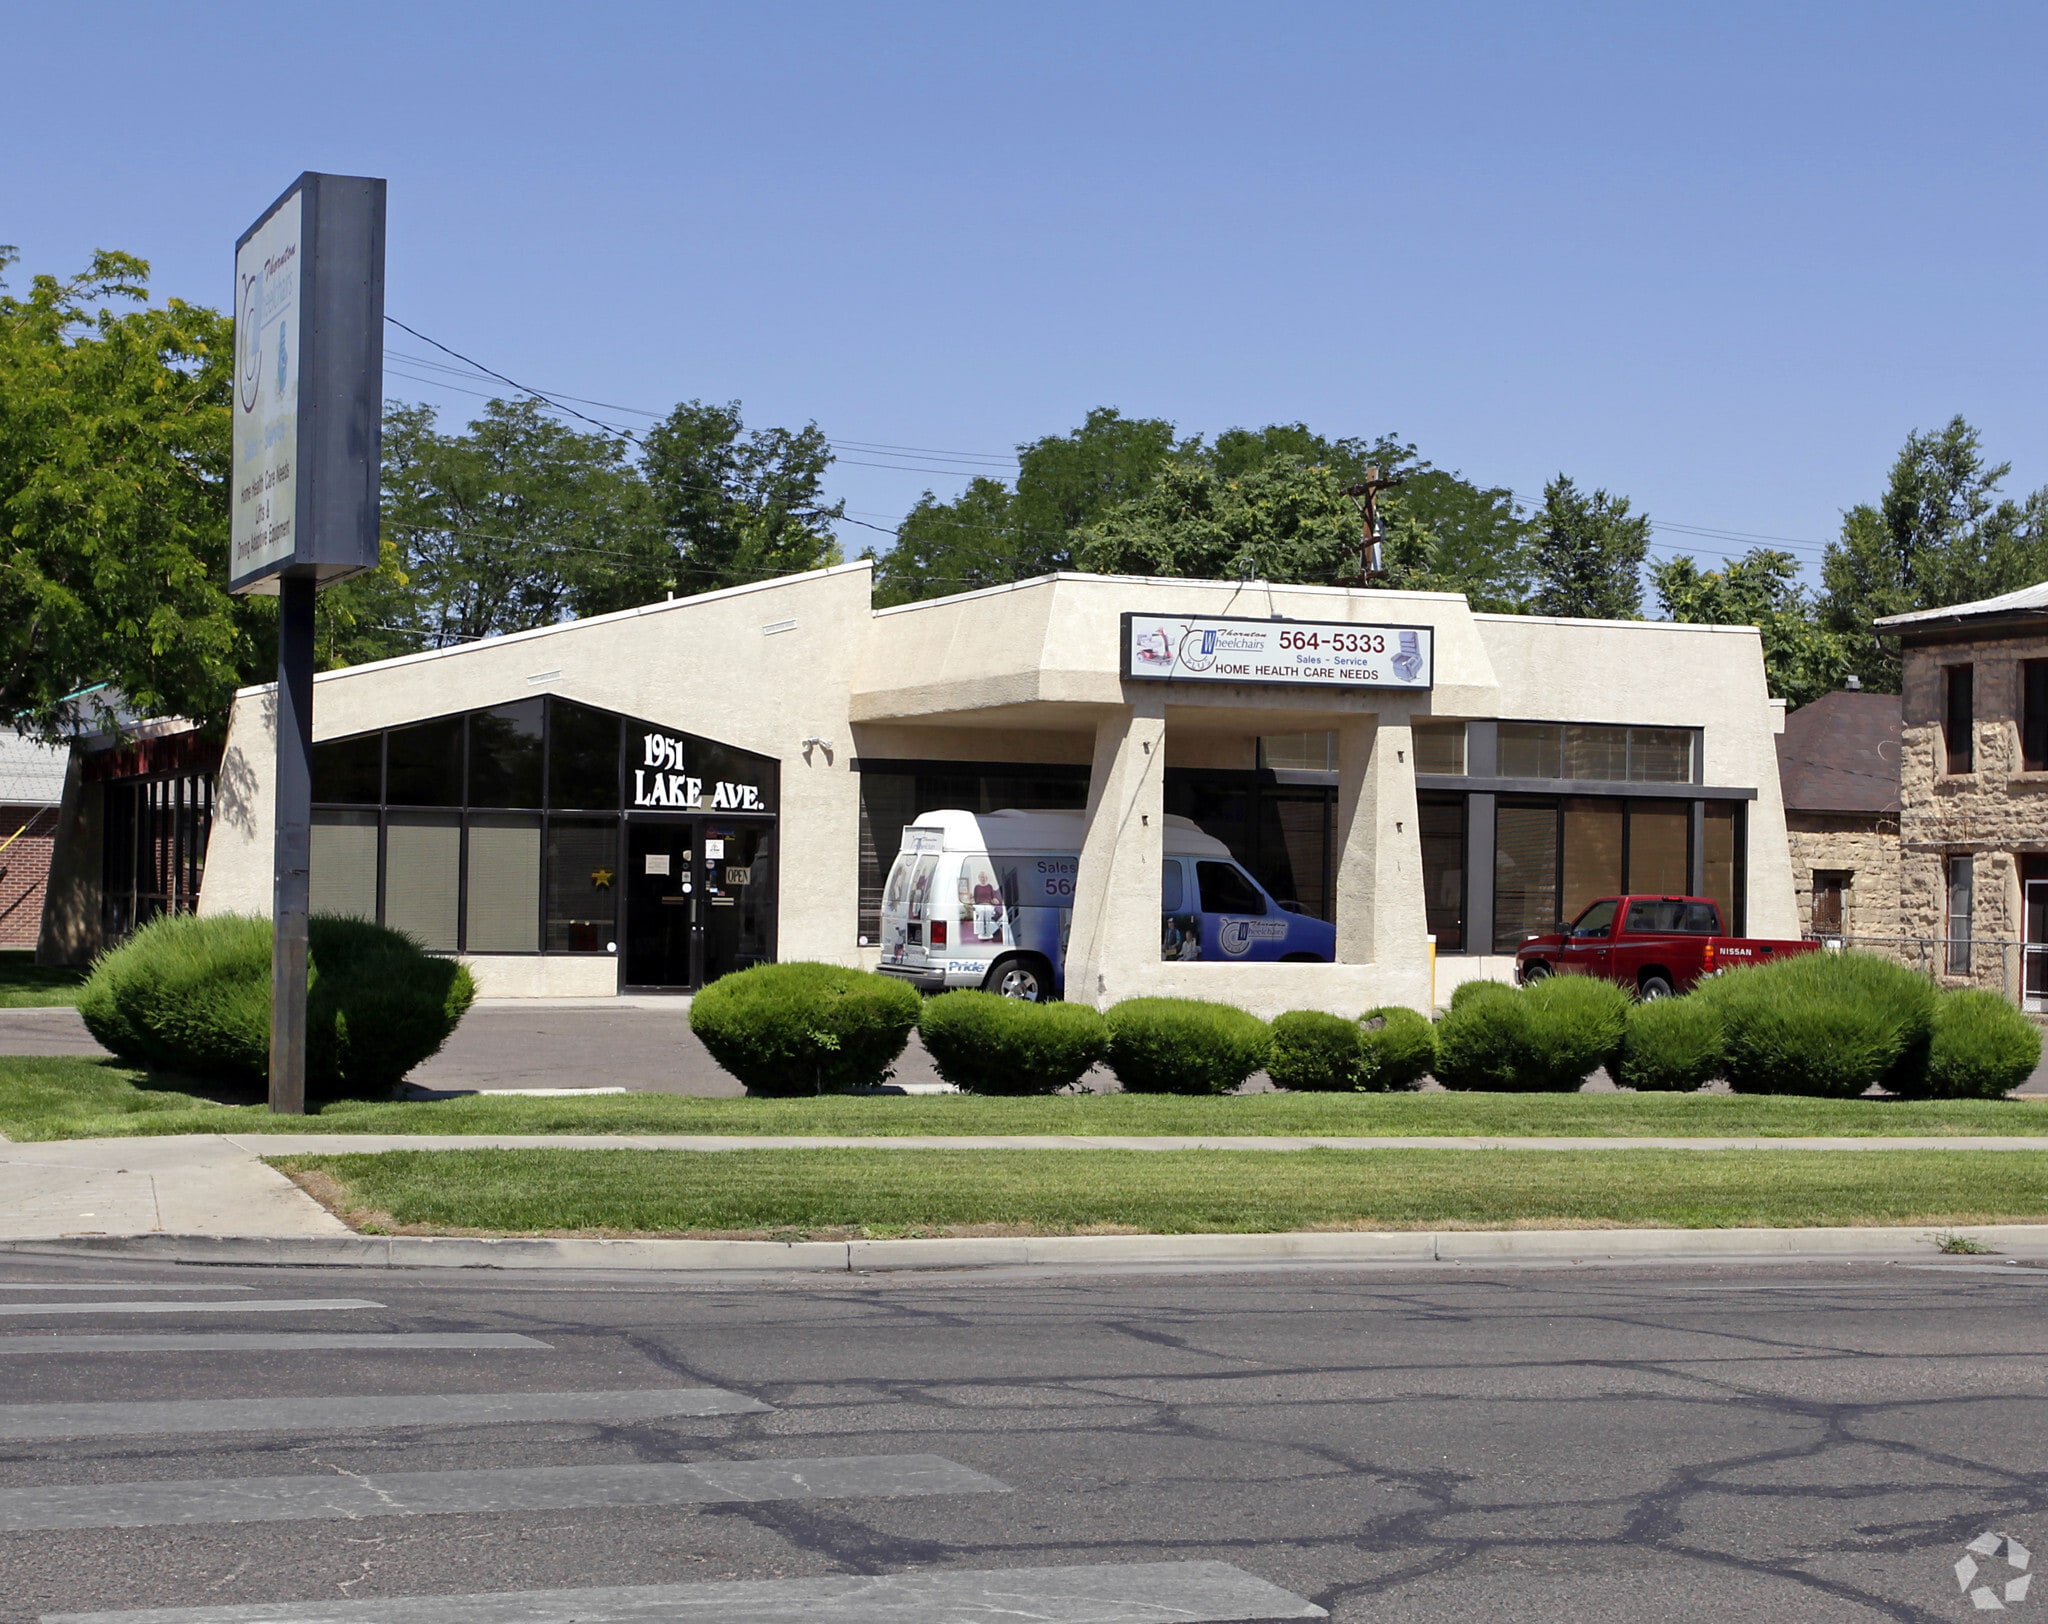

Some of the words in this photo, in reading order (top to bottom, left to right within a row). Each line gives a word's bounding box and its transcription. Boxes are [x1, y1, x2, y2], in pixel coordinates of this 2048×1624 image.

[1217, 629, 1267, 637] Thornton
[1202, 631, 1264, 653] Wheelchairs
[1279, 631, 1385, 653] 564-5333
[1296, 654, 1321, 664] Sales
[1334, 656, 1368, 666] Service
[1215, 664, 1250, 675] HOME
[1255, 665, 1299, 677] HEALTH
[1303, 667, 1334, 678] CARE
[1339, 669, 1379, 680] NEEDS
[643, 733, 685, 771] 1951
[634, 769, 702, 809] LAKE
[710, 781, 765, 810] AVE.
[1037, 861, 1077, 874] Sales
[727, 869, 748, 883] OPEN
[1719, 947, 1752, 956] NISSAN
[948, 961, 985, 973] Pride
